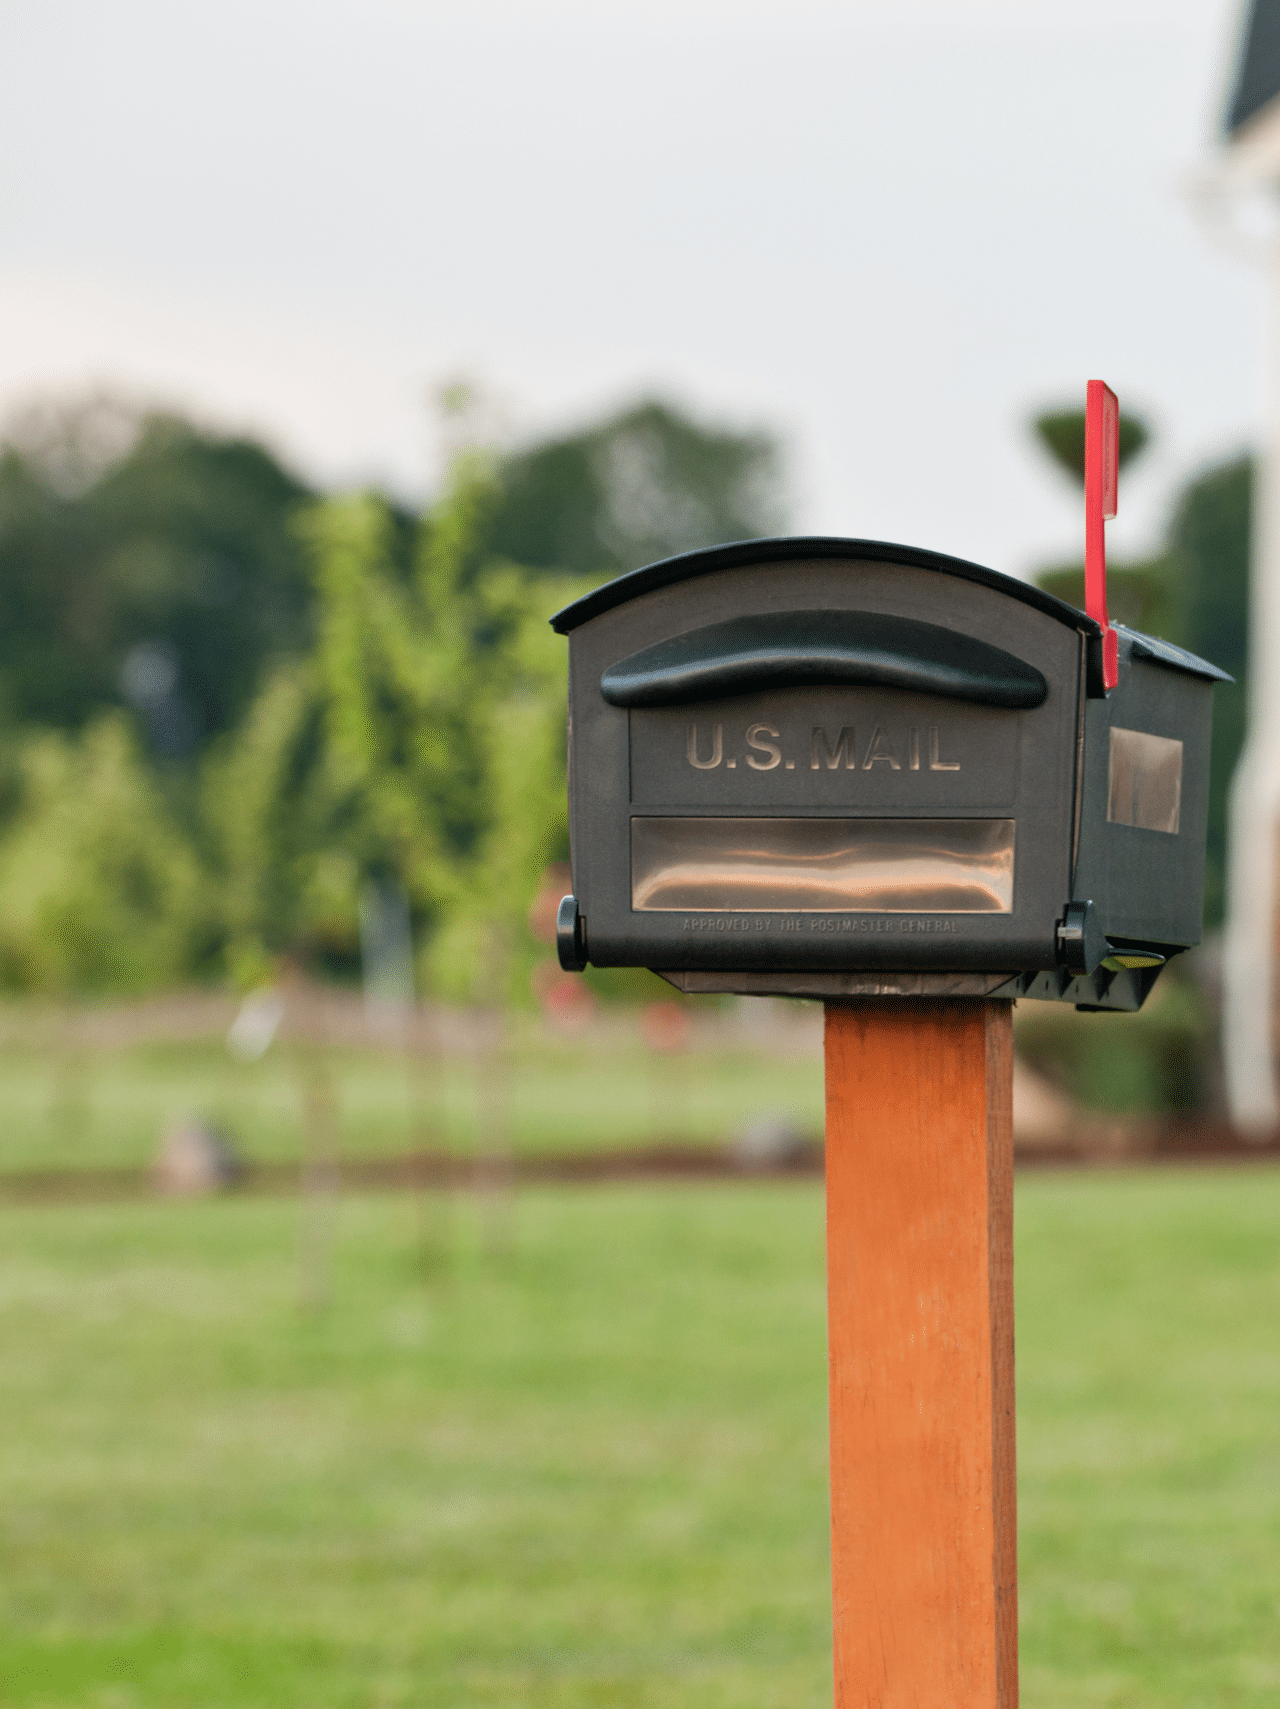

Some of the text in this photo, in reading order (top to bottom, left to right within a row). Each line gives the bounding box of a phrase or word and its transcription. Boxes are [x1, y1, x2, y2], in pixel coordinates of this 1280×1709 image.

[687, 723, 961, 771] U.S. MAIL
[683, 919, 958, 932] APPROVED BY THE POSTMASTER GENERAL
